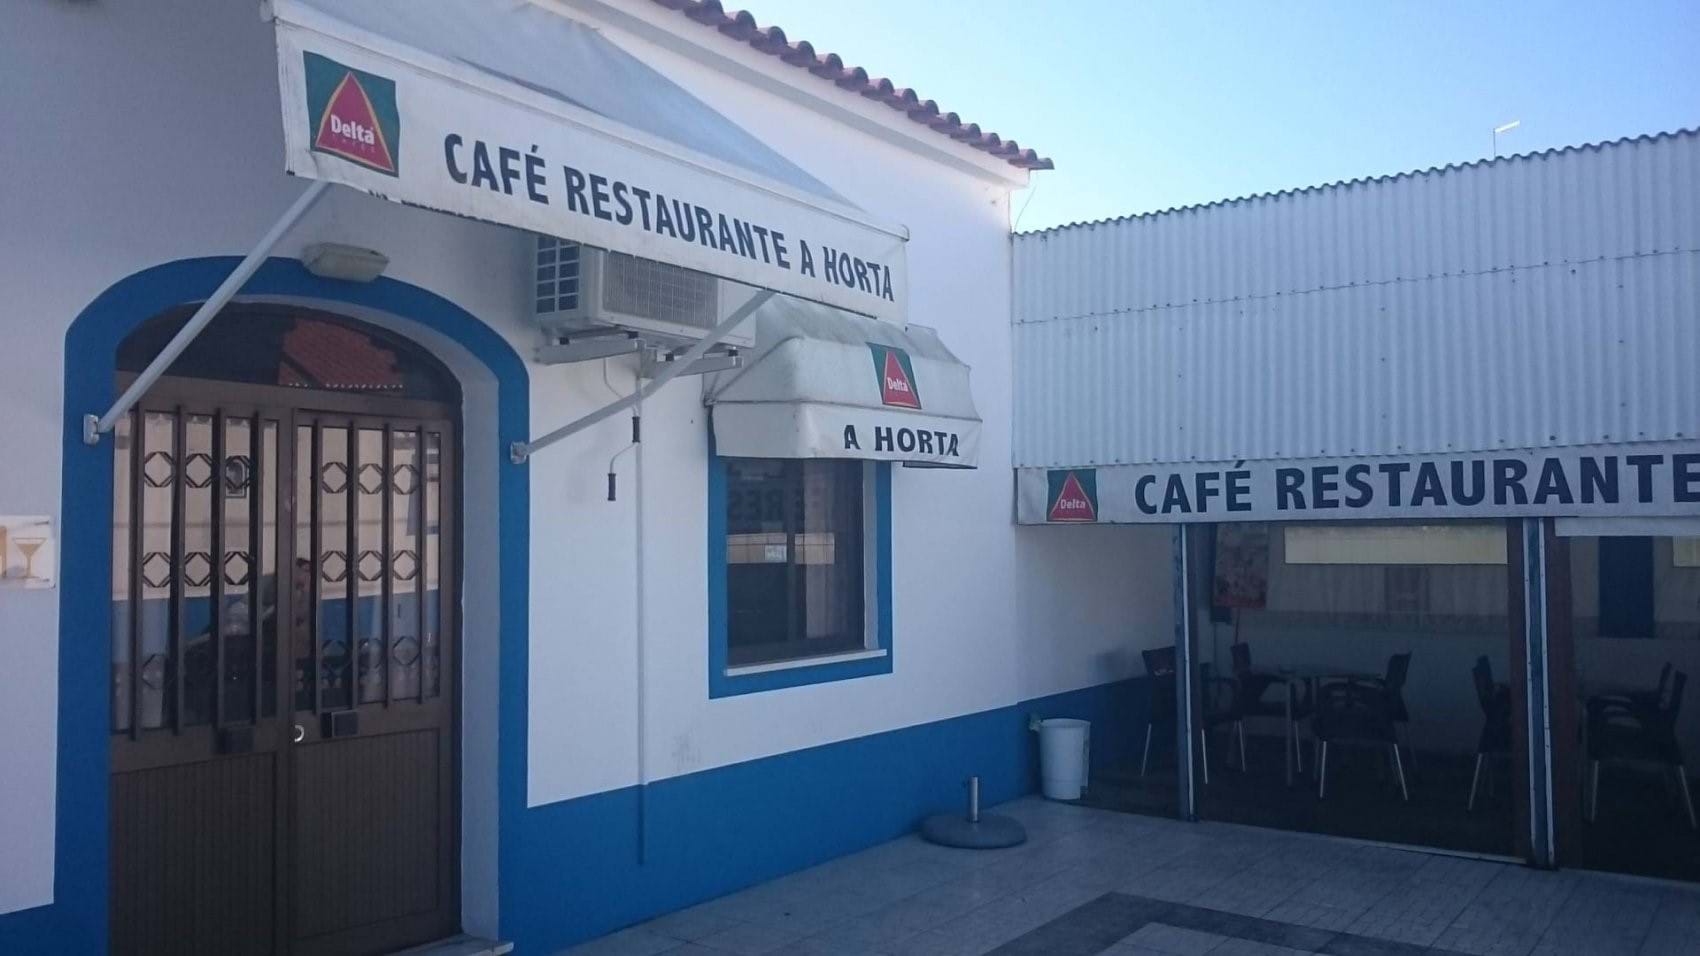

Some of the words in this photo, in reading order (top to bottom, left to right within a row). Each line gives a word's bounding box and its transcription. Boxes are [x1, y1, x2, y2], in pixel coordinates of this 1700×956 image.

[331, 114, 375, 145] Delta
[444, 133, 550, 205] CAFÉ
[564, 165, 791, 270] RESTAURANTE
[800, 239, 816, 278] A
[822, 246, 894, 302] HORTA
[887, 377, 909, 392] Delta
[843, 424, 861, 450] A
[874, 426, 960, 457] HORTA
[1134, 459, 1252, 515] CAFÉ
[1275, 452, 1700, 511] RESTAURANTE
[1061, 499, 1086, 509] Delta
